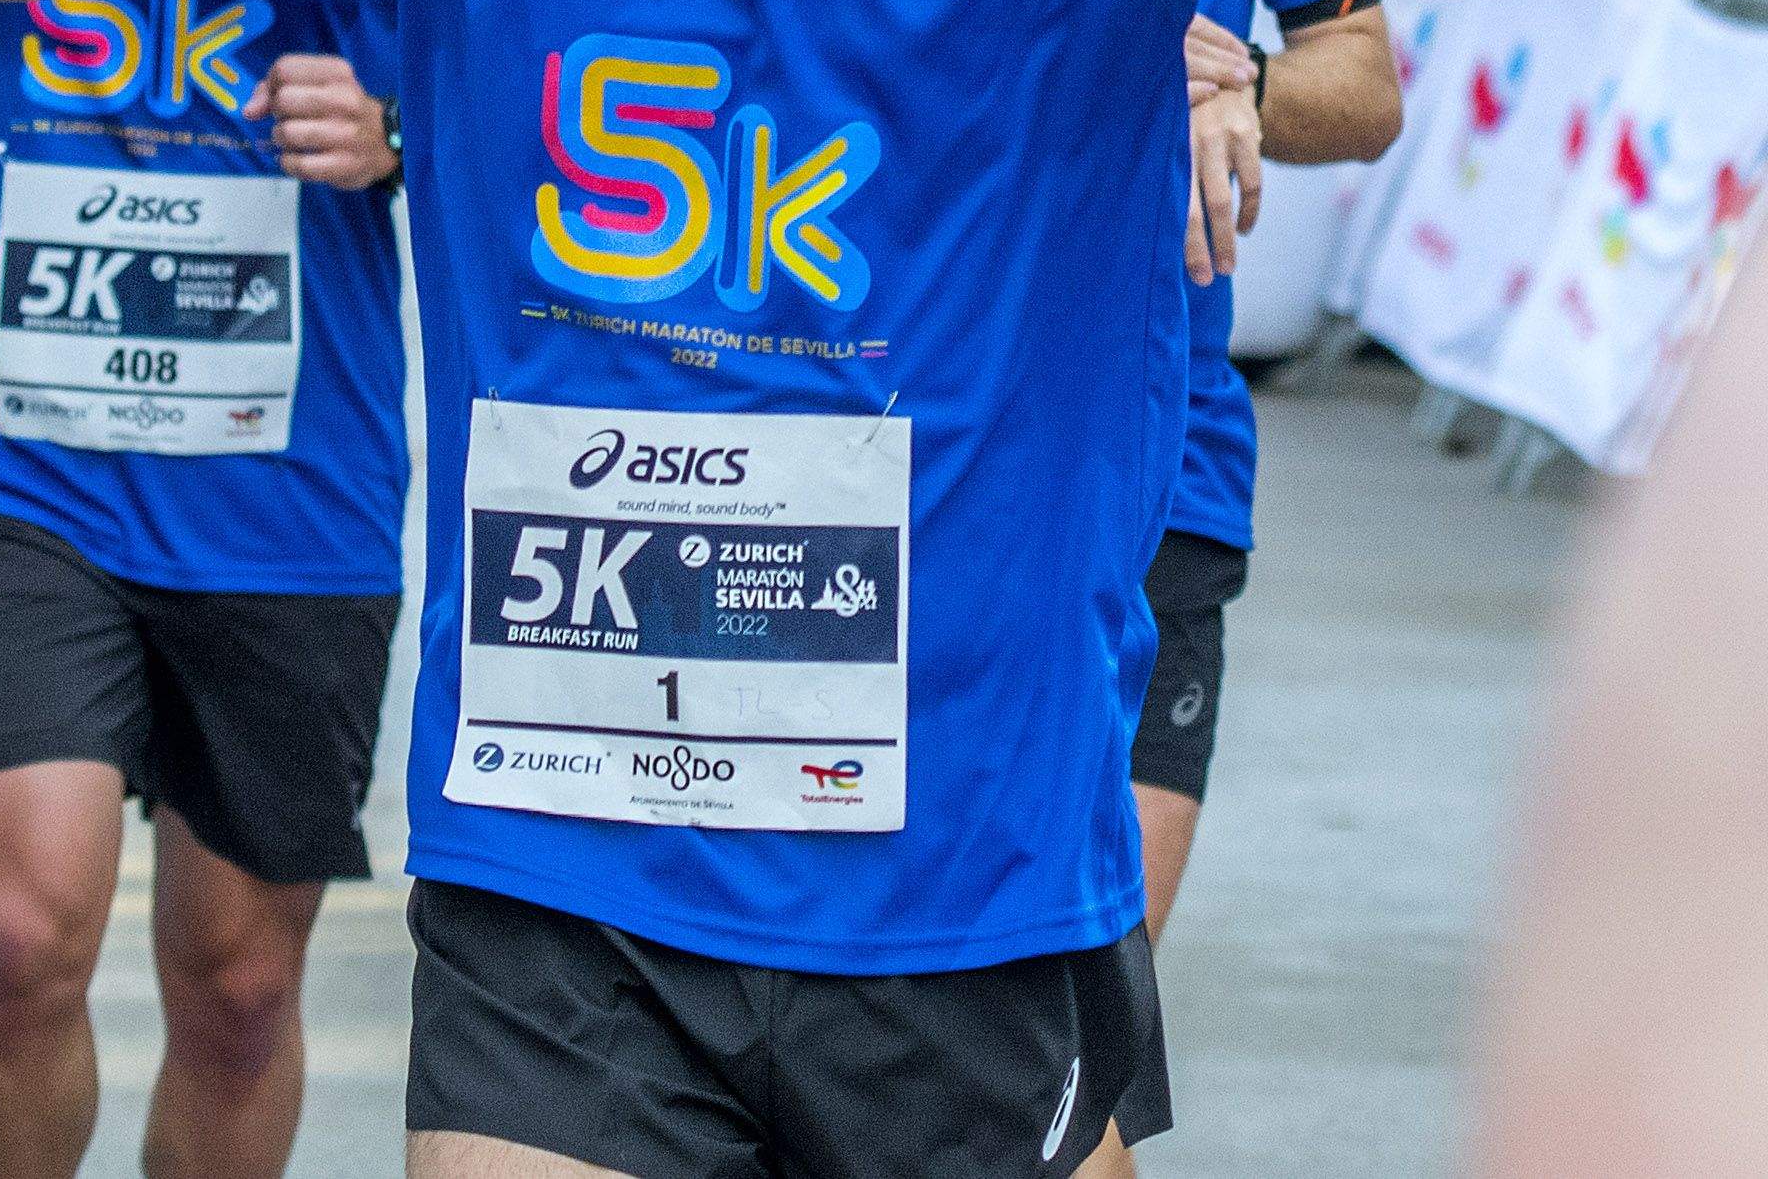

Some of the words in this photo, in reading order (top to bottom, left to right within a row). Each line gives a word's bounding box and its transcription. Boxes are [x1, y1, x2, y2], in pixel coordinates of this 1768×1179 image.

[118, 196, 202, 225] asics
[18, 247, 134, 321] 5K
[641, 320, 743, 350] MARATÓN
[747, 335, 774, 354] DE
[780, 337, 857, 360] SEVILLA
[105, 348, 179, 385] 408
[671, 346, 718, 369] 2022
[626, 445, 750, 486] asics
[617, 498, 657, 513] sound
[658, 499, 692, 516] mind,
[695, 500, 738, 515] sound
[719, 543, 804, 563] ZURICH
[500, 525, 654, 630] 5K
[716, 567, 805, 588] MARATÓN
[715, 588, 805, 610] SEVILLA
[716, 613, 769, 636] 2022
[507, 624, 600, 648] BREAKFAST
[603, 631, 639, 650] RUN
[656, 670, 679, 722] 1
[509, 751, 602, 774] ZURICH
[799, 793, 864, 806] TotalEnergies
